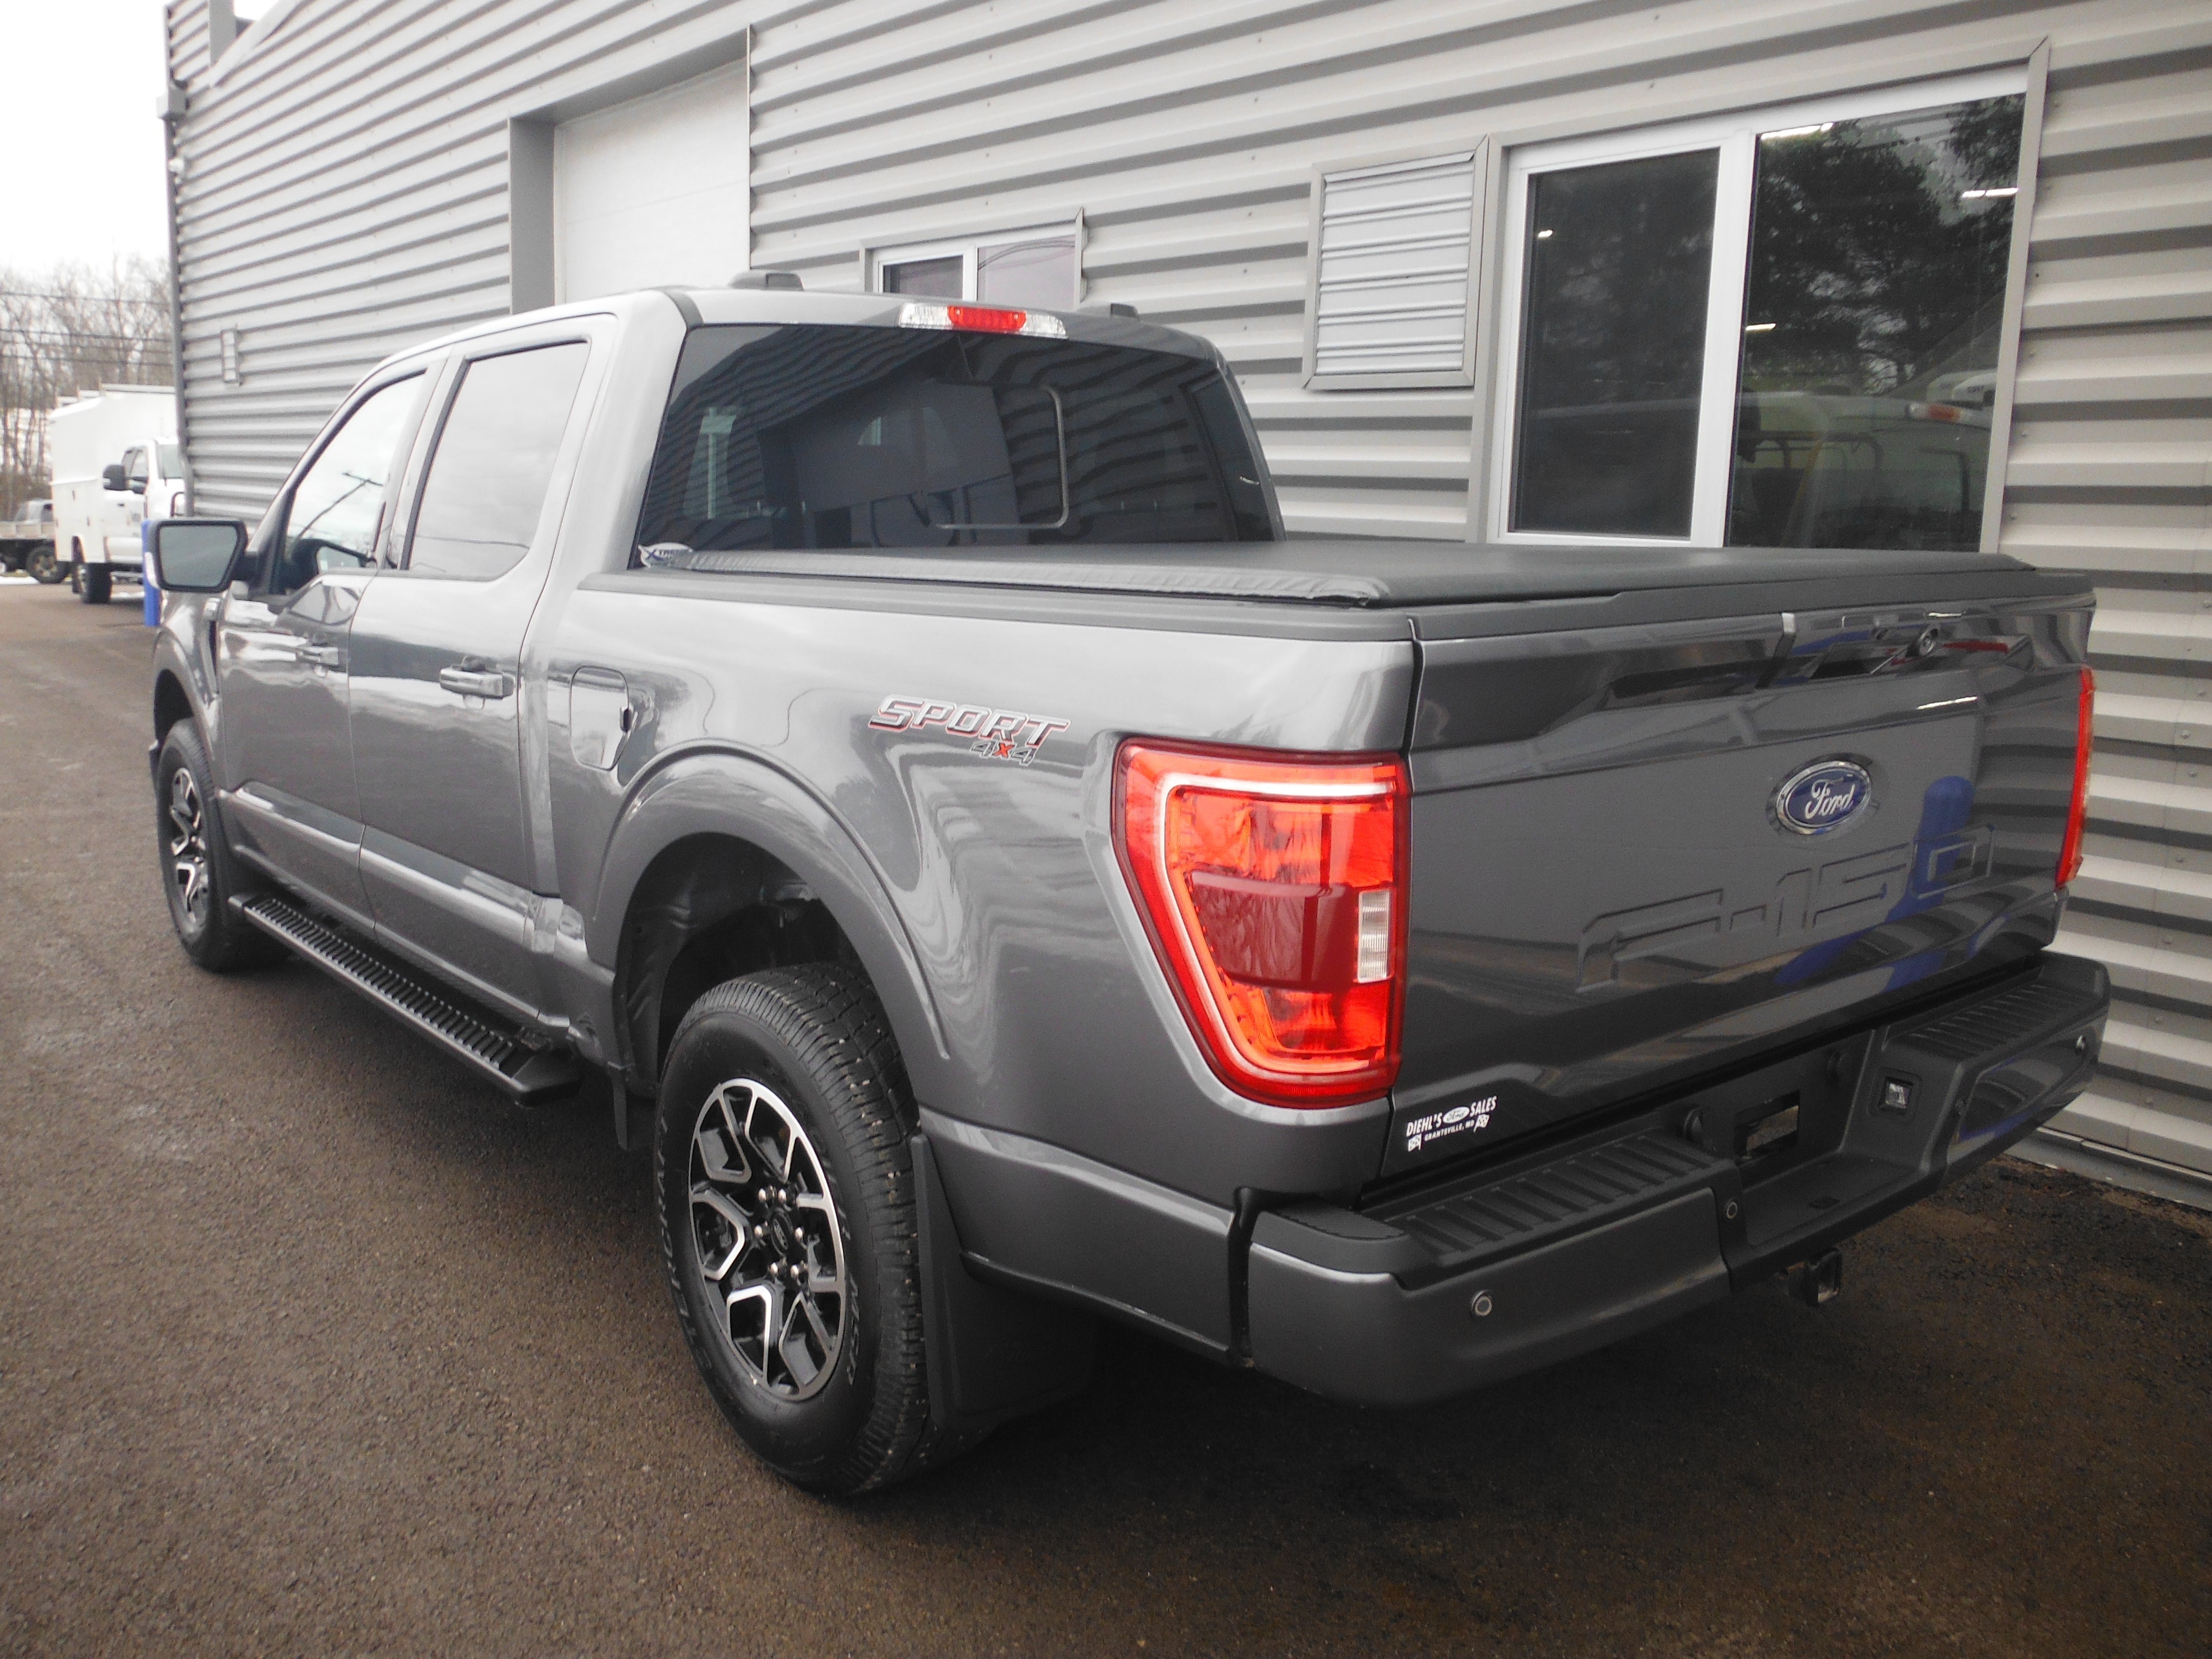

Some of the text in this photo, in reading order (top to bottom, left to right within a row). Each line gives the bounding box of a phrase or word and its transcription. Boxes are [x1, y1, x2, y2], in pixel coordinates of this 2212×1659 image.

[868, 694, 1071, 748] SPORT
[1804, 777, 1856, 820] Ford
[1576, 824, 1996, 994] F-150
[1406, 1112, 1443, 1137] DIEHL'S
[1470, 1095, 1497, 1117] SALES
[1424, 1119, 1475, 1142] GRANTSVILLE, MD
